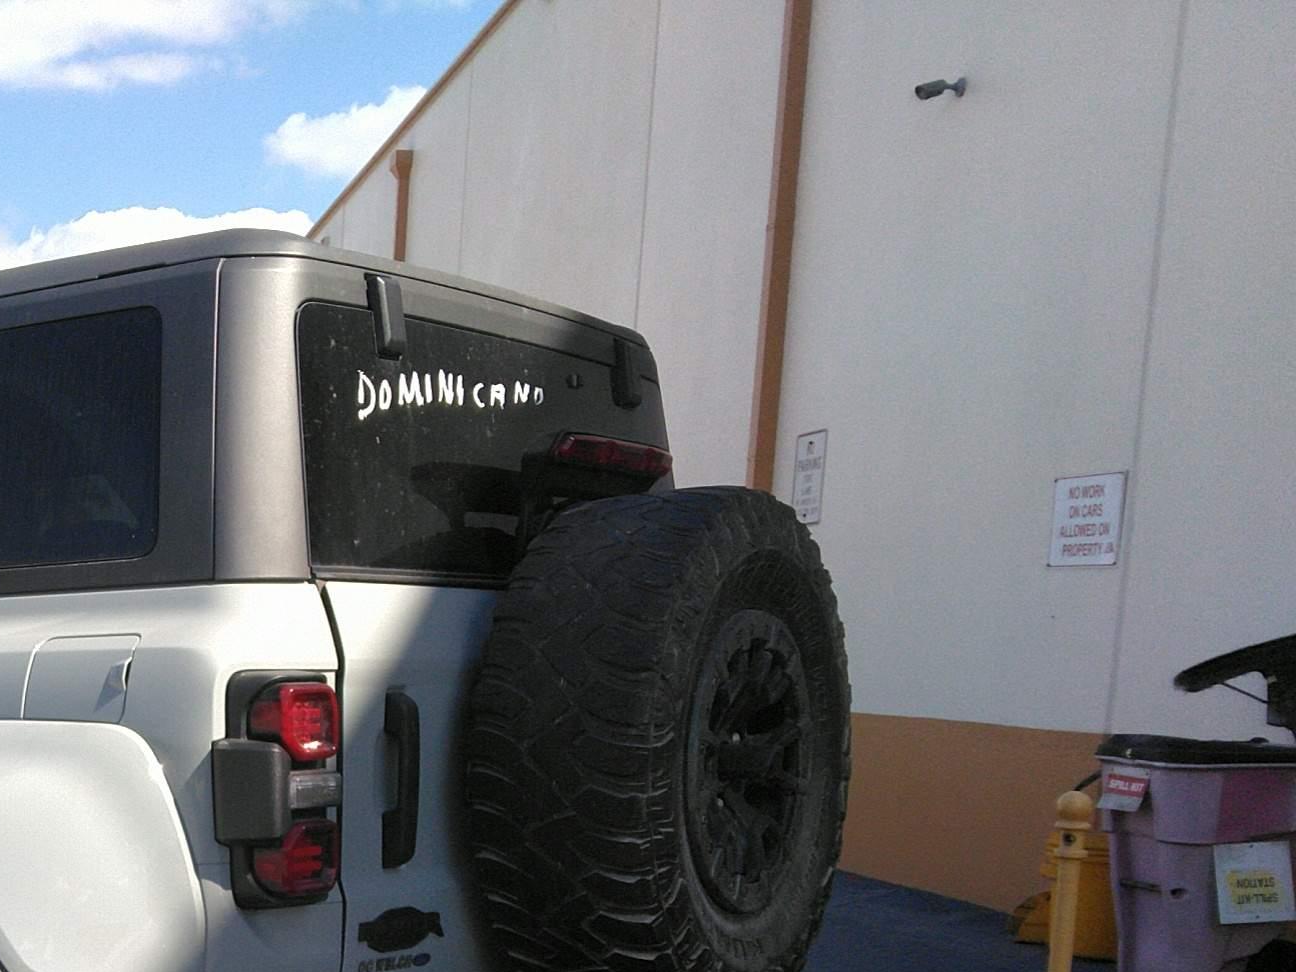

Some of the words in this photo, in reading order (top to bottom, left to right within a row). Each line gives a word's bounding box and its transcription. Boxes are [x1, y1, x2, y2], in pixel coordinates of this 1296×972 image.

[1108, 779, 1129, 791] SPILL
[1131, 782, 1145, 792] KIT
[1236, 876, 1275, 889] STATION
